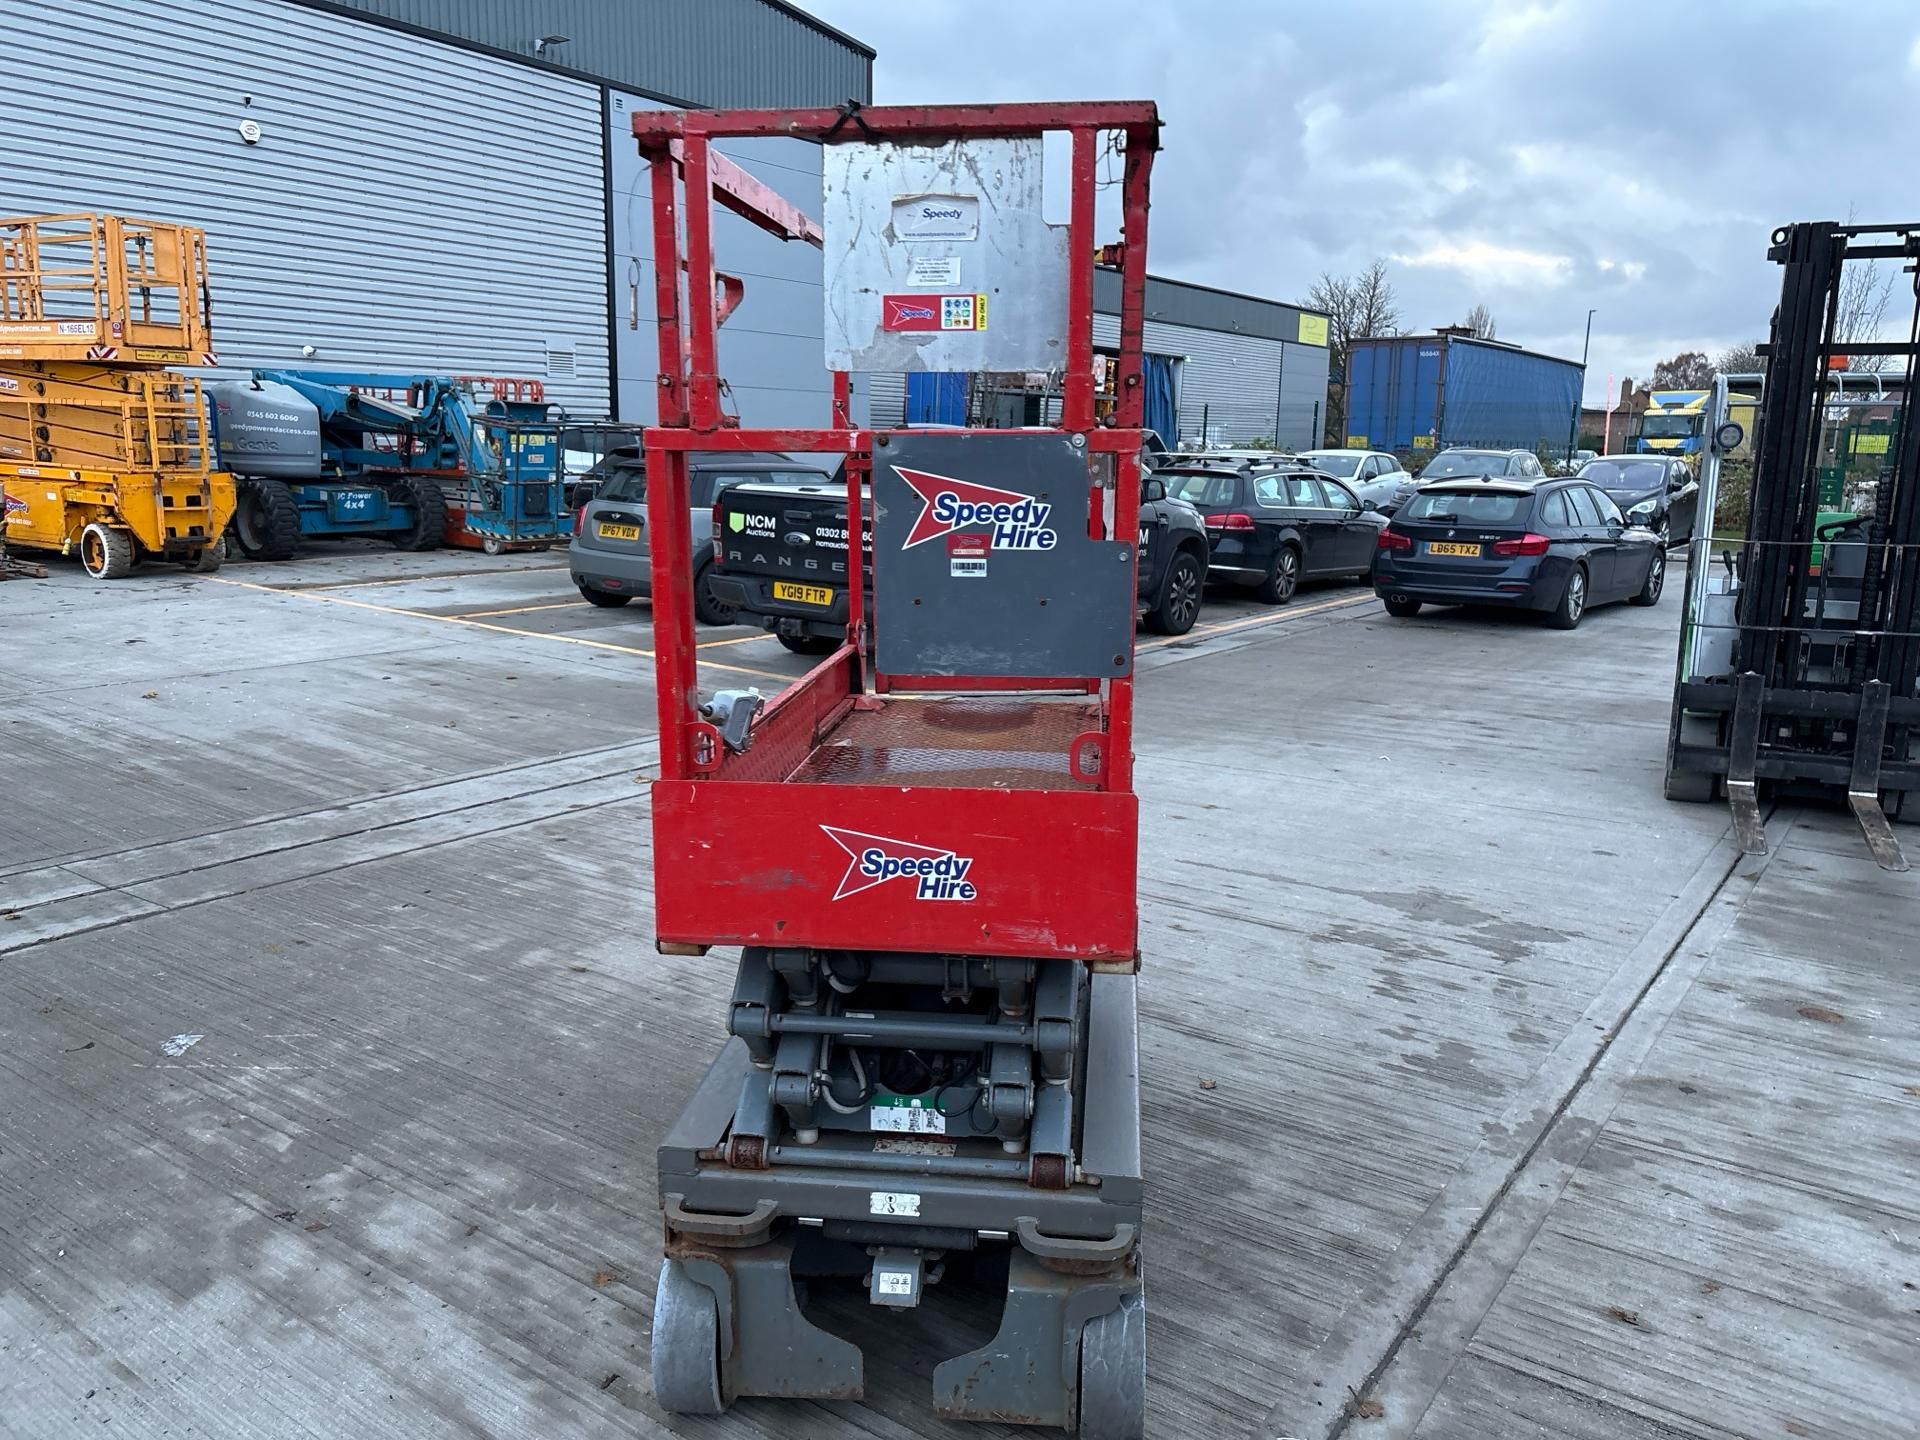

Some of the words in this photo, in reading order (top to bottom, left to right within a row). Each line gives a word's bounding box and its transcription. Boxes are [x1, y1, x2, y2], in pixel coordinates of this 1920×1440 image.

[922, 207, 962, 220] Speedy
[900, 308, 933, 319] Speedy
[265, 412, 279, 420] 602
[237, 437, 280, 452] Genie
[347, 492, 373, 500] Power
[343, 500, 365, 509] 4x4
[934, 493, 1049, 528] Speedy
[746, 514, 776, 529] NCM
[745, 528, 776, 538] Auctions
[815, 527, 840, 539] 01302
[993, 524, 1055, 549] Hire
[1459, 545, 1479, 555] TXZ
[780, 584, 804, 601] YG19
[805, 588, 826, 603] FTR
[863, 849, 971, 881] Speedy
[918, 877, 976, 899] Hire
